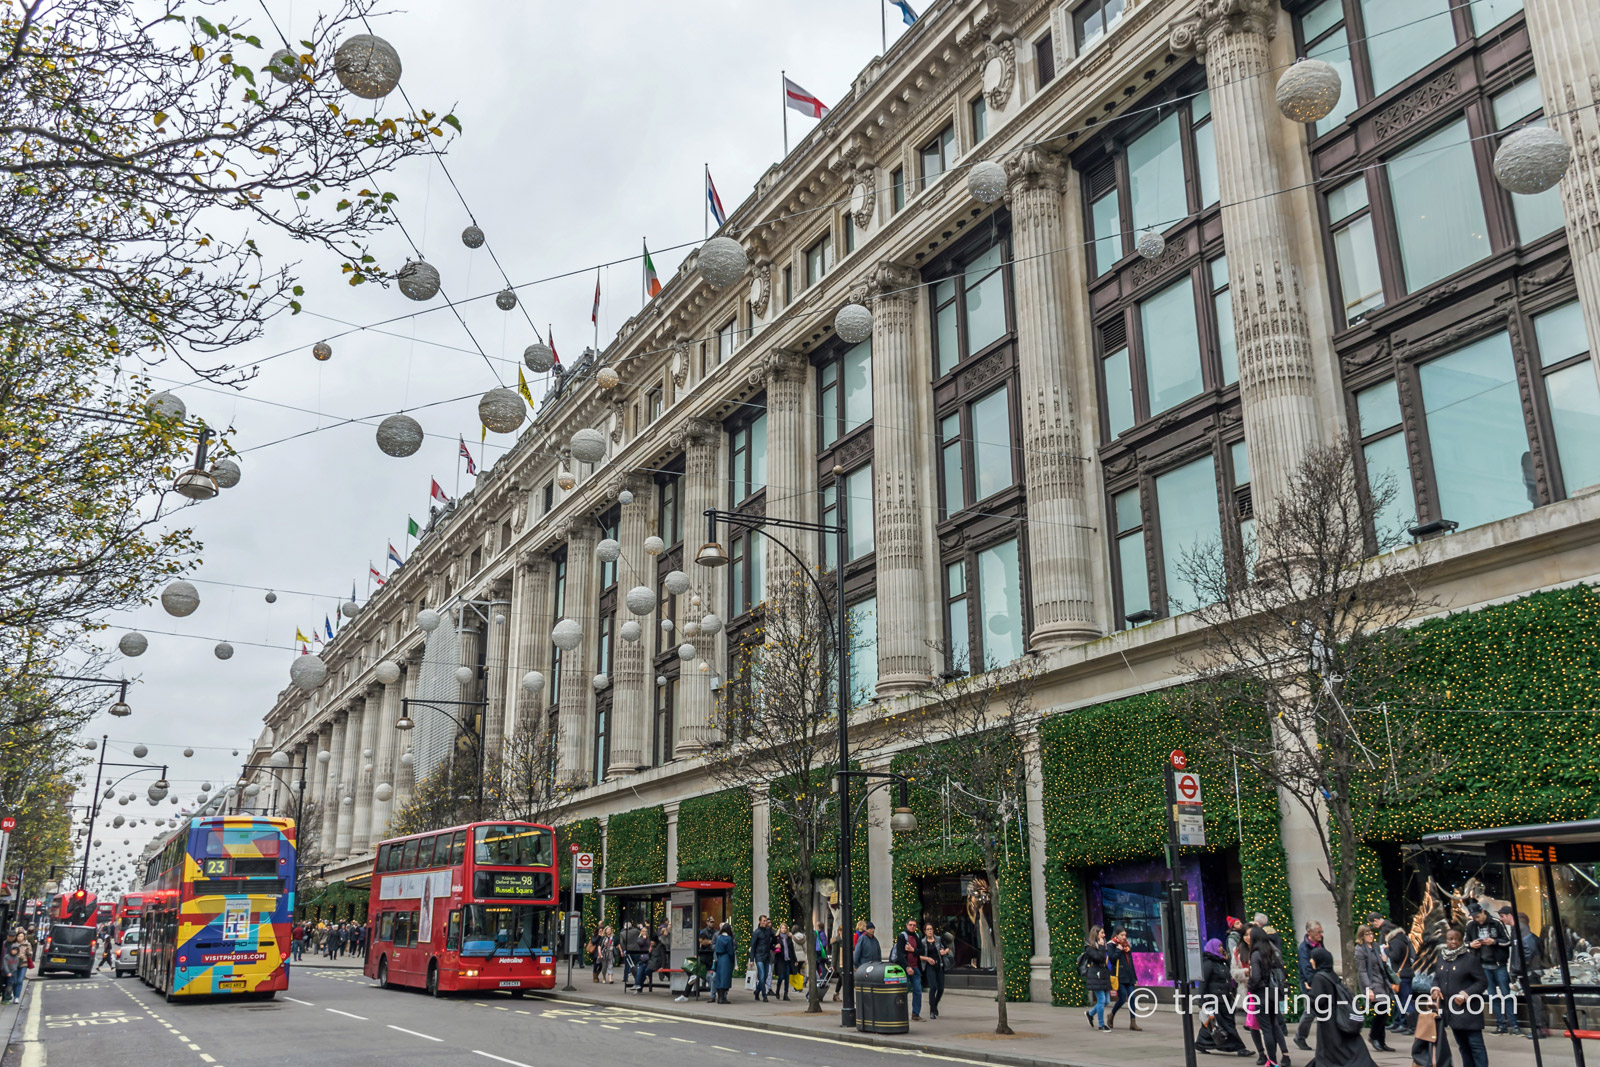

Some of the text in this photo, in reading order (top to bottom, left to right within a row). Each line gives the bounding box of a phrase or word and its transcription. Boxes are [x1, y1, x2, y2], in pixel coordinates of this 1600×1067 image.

[1173, 755, 1185, 765] BC
[207, 860, 225, 874] 23
[521, 875, 533, 886] 98
[495, 886, 534, 895] Russell Square
[228, 912, 247, 924] 20
[226, 923, 246, 936] 15
[204, 953, 265, 961] VISITPH2015.COM
[45, 1010, 126, 1021] BUS
[45, 1016, 144, 1029] STOP
